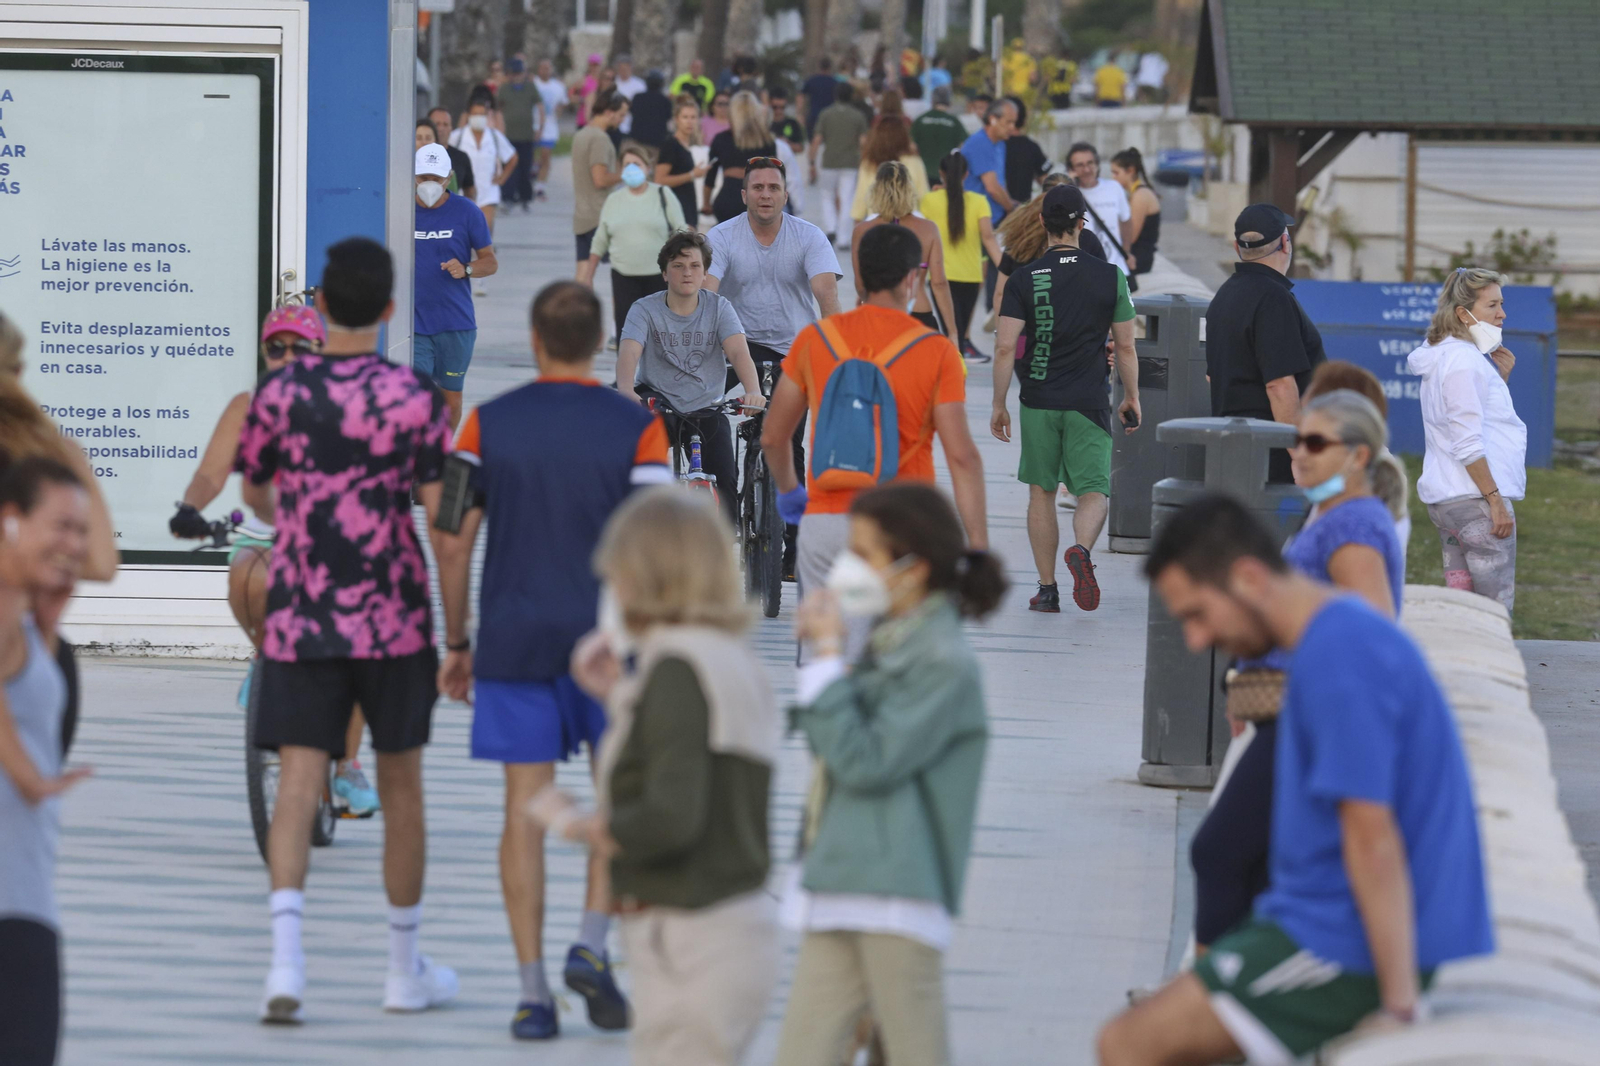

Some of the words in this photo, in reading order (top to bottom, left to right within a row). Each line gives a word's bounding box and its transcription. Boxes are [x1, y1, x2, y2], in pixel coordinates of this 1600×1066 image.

[71, 58, 124, 69] JCDecaux
[414, 230, 453, 240] EAD
[41, 238, 98, 252] Lávate
[103, 239, 126, 252] las
[131, 241, 192, 254] manos.
[41, 258, 61, 272] La
[66, 258, 128, 274] higiene
[133, 262, 152, 273] es
[157, 260, 171, 273] la
[1059, 256, 1078, 264] UFC
[41, 279, 90, 293] mejor
[95, 279, 194, 294] prevención.
[40, 321, 83, 334] Evita
[88, 322, 231, 337] desplazamientos
[1029, 274, 1054, 380] MCGREGOR
[40, 341, 145, 355] innecesarios
[150, 345, 160, 358] y
[165, 342, 235, 357] quédate
[40, 363, 60, 374] en
[65, 363, 108, 375] casa.
[112, 407, 122, 418] a
[127, 405, 151, 418] los
[156, 406, 190, 419] más
[58, 424, 141, 438] lnerables.
[81, 445, 198, 460] sponsabilidad
